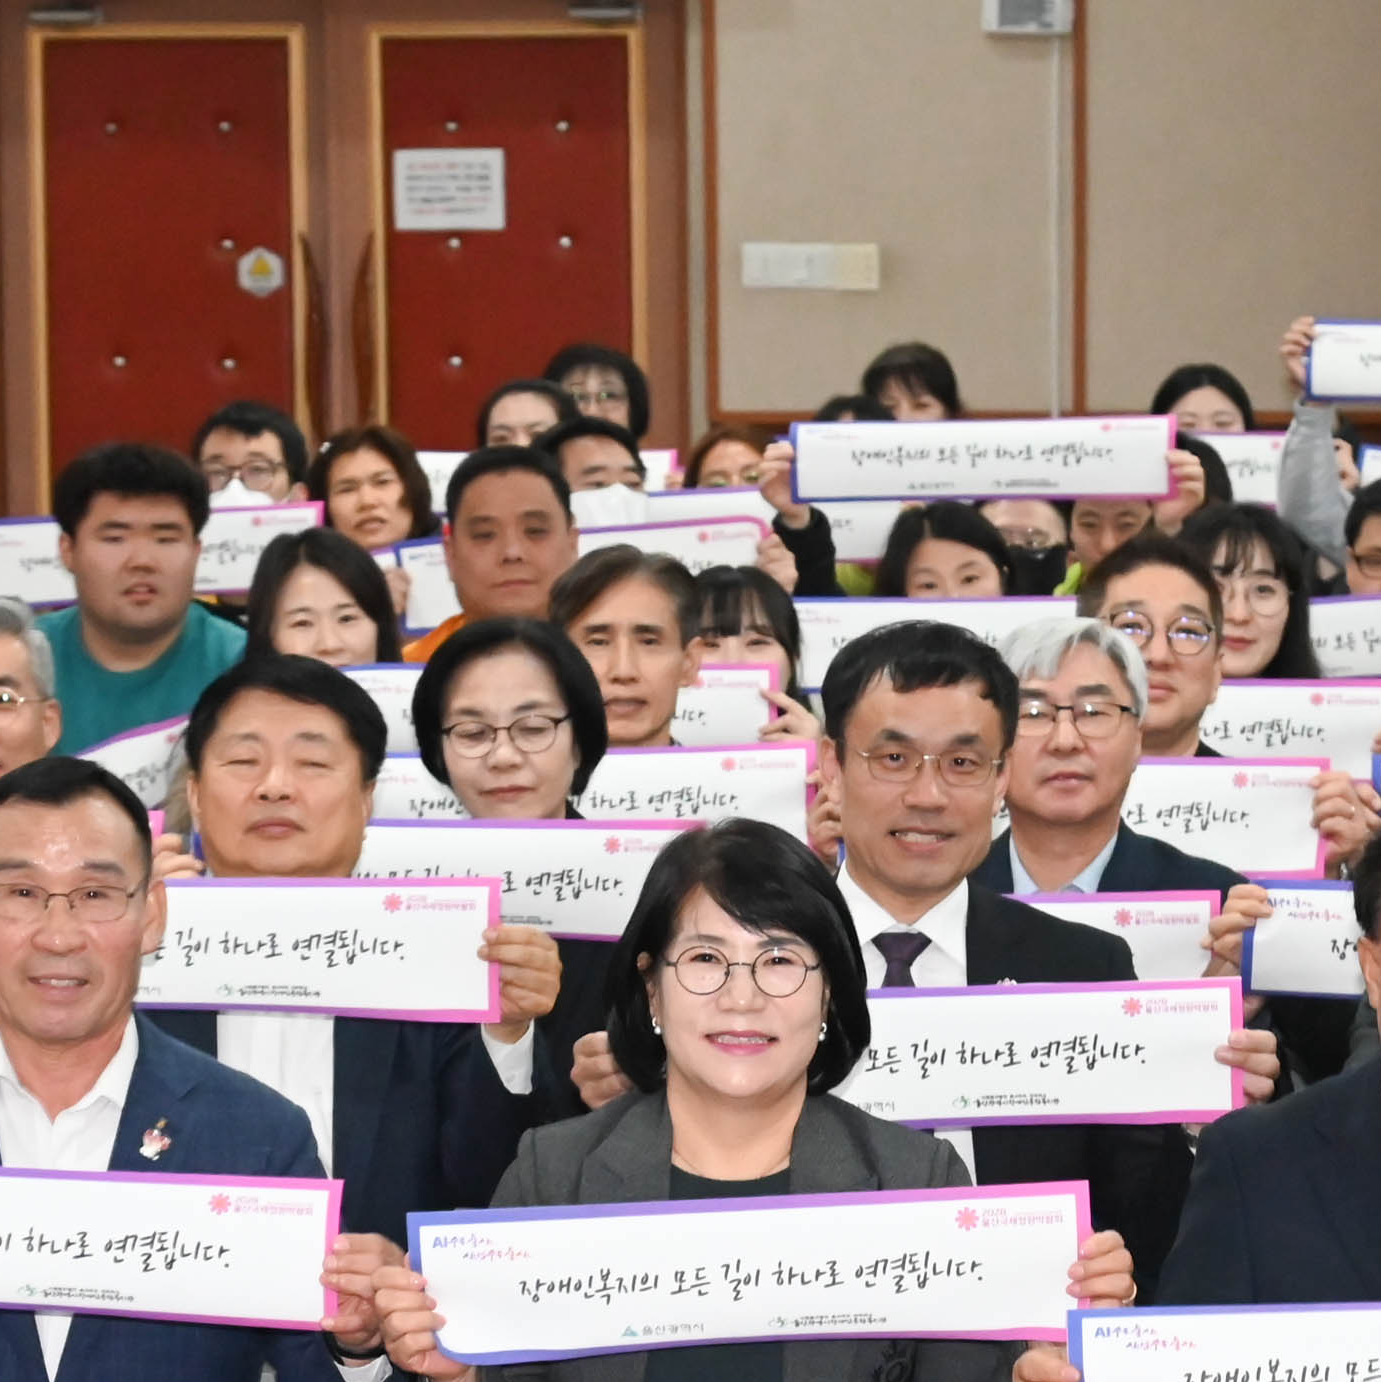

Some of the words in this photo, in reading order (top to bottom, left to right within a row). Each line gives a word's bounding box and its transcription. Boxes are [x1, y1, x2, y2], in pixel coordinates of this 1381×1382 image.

[589, 790, 641, 812] 하나로
[647, 785, 743, 821] 연결됩니다.
[1155, 801, 1250, 834] 연결됩니다.
[525, 867, 624, 903] 연결됩니다.
[175, 927, 210, 968] 길이
[218, 931, 283, 959] 하나로
[291, 928, 405, 969] 연결됩니다.
[910, 1038, 947, 1080] 길이
[955, 1040, 1022, 1068] 하나로
[1030, 1033, 1146, 1075] 연결됩니다.
[22, 1227, 94, 1260] 하나로
[104, 1230, 230, 1273] 연결됩니다.
[518, 1267, 659, 1306] 장애인복지의
[670, 1266, 711, 1297] 모든
[721, 1258, 761, 1302] 길이
[771, 1260, 845, 1289] 하나로
[854, 1250, 983, 1295] 연결됩니다.
